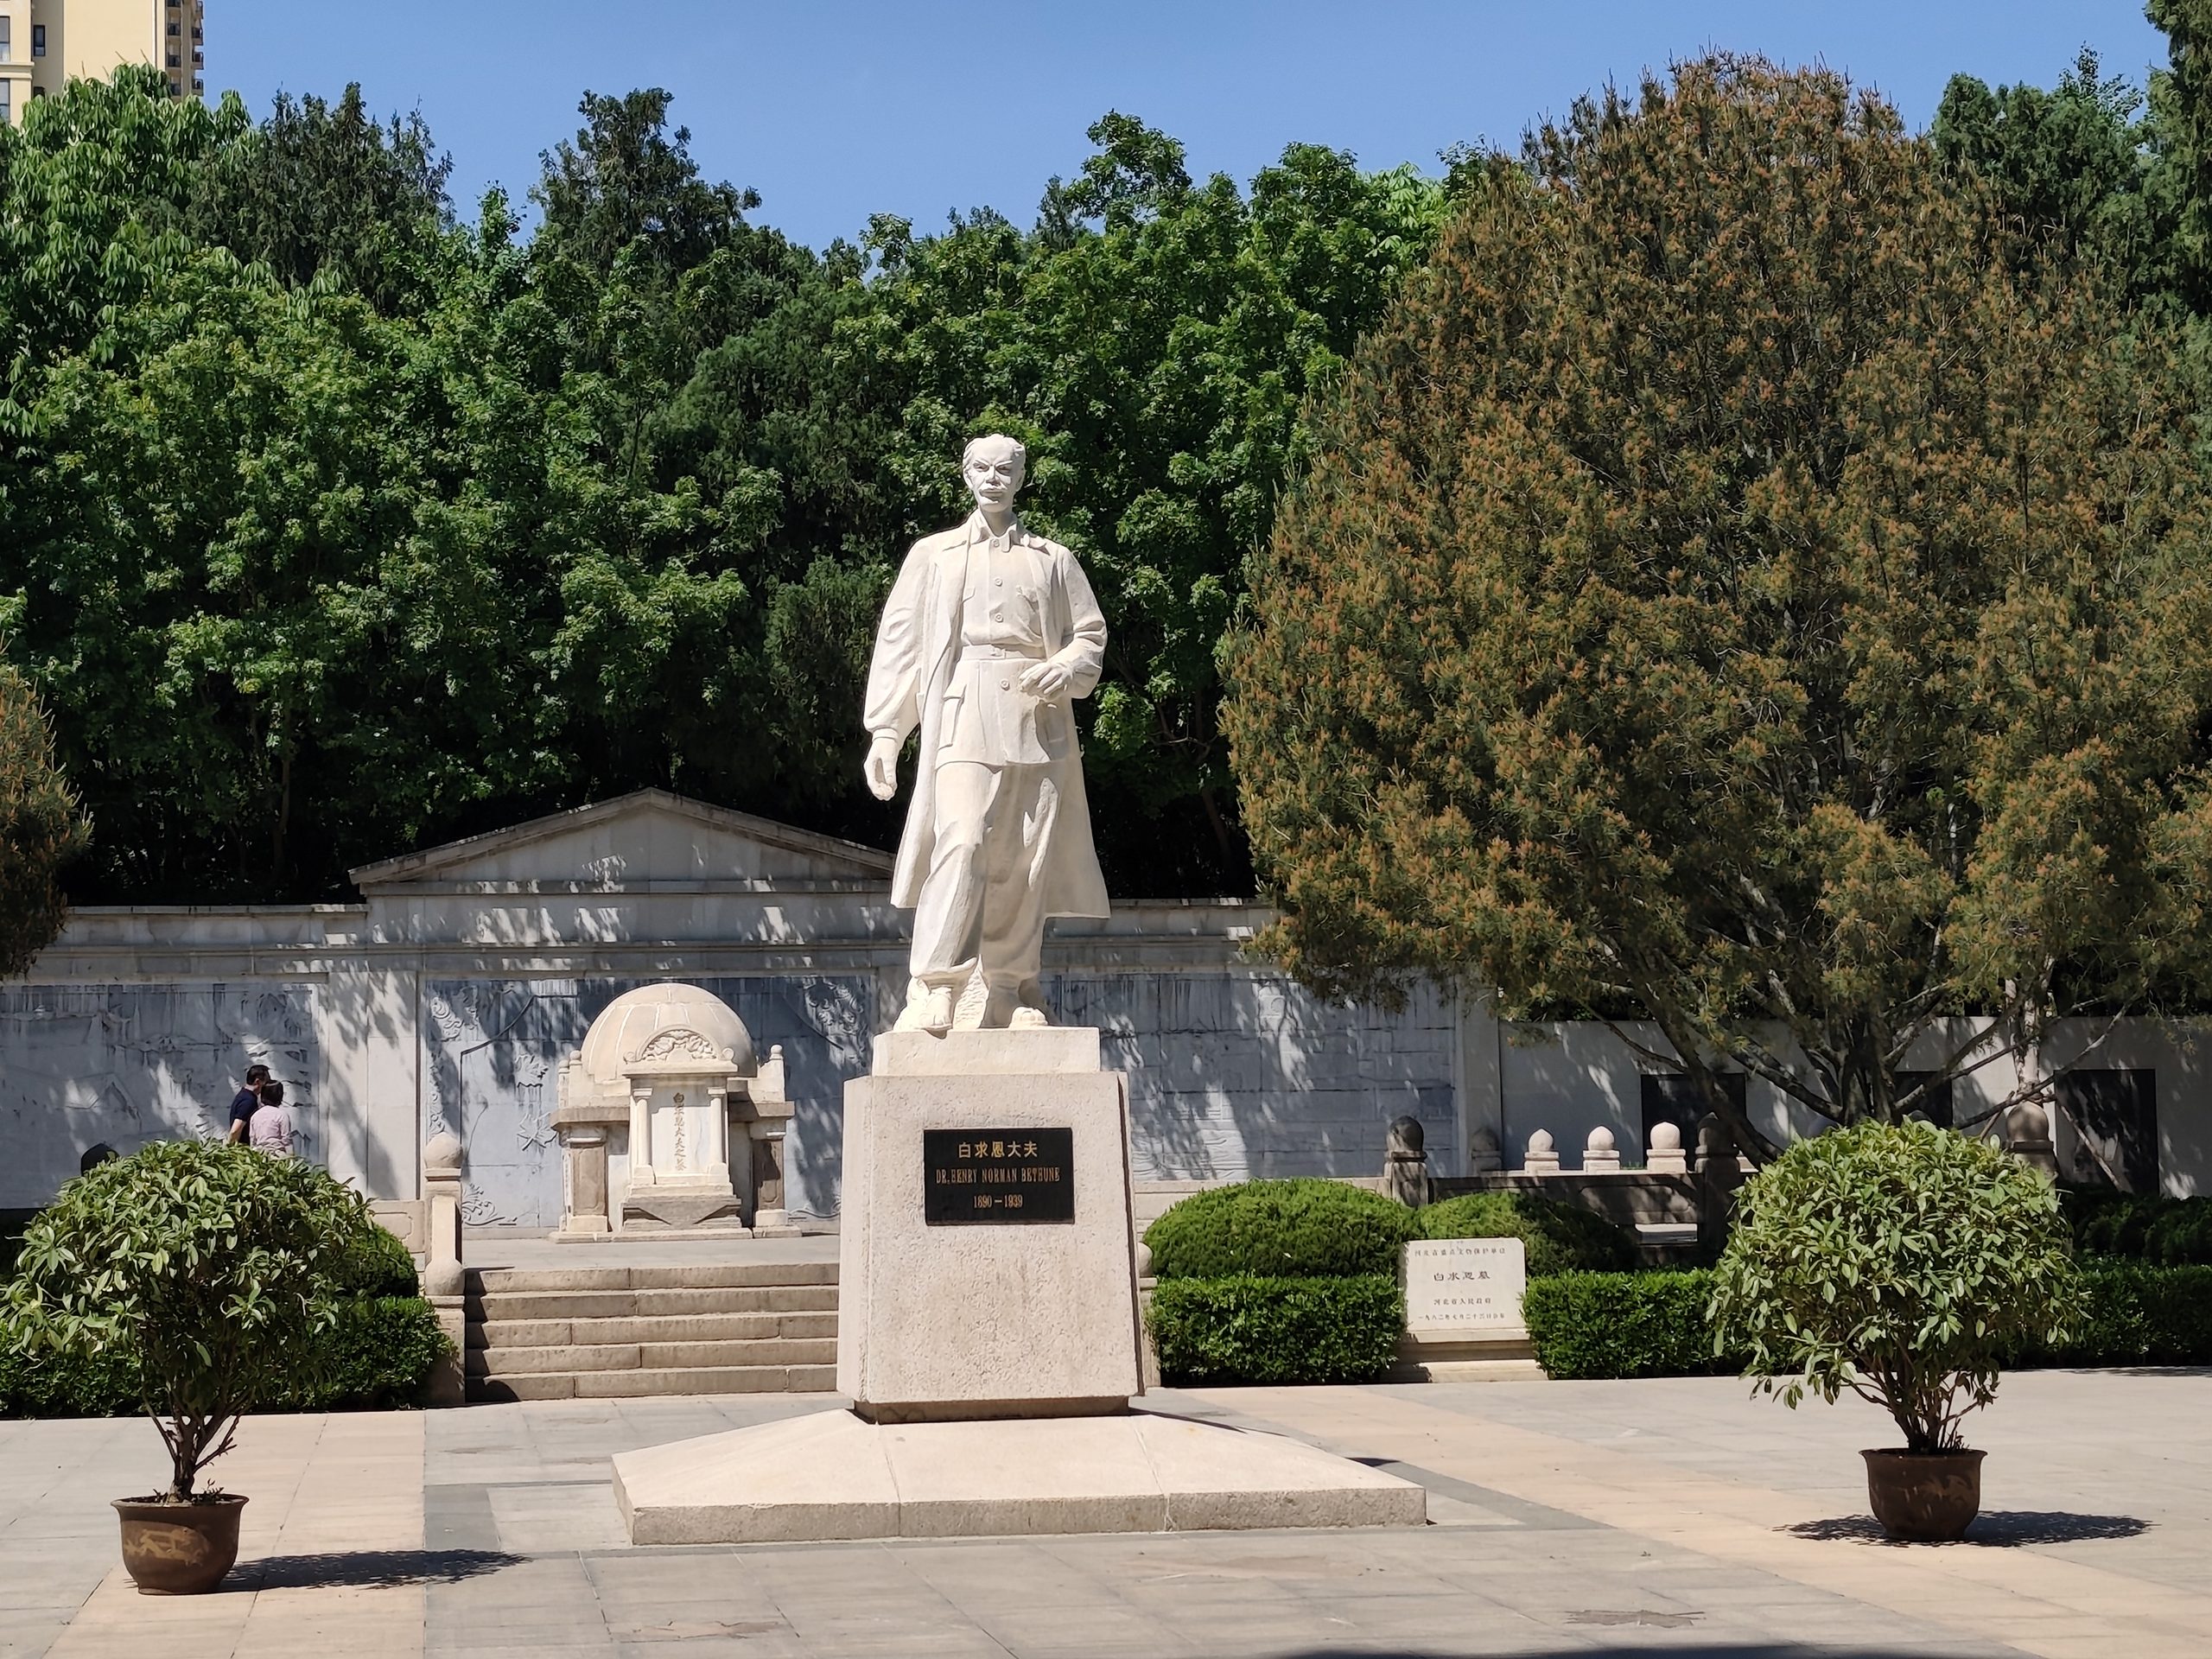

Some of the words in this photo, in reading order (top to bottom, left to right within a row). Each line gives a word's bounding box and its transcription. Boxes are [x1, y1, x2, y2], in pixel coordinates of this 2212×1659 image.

[958, 1141, 1038, 1159] 白求恩大夫
[982, 1168, 1018, 1184] NORMAN
[1021, 1167, 1060, 1183] BETHUNE
